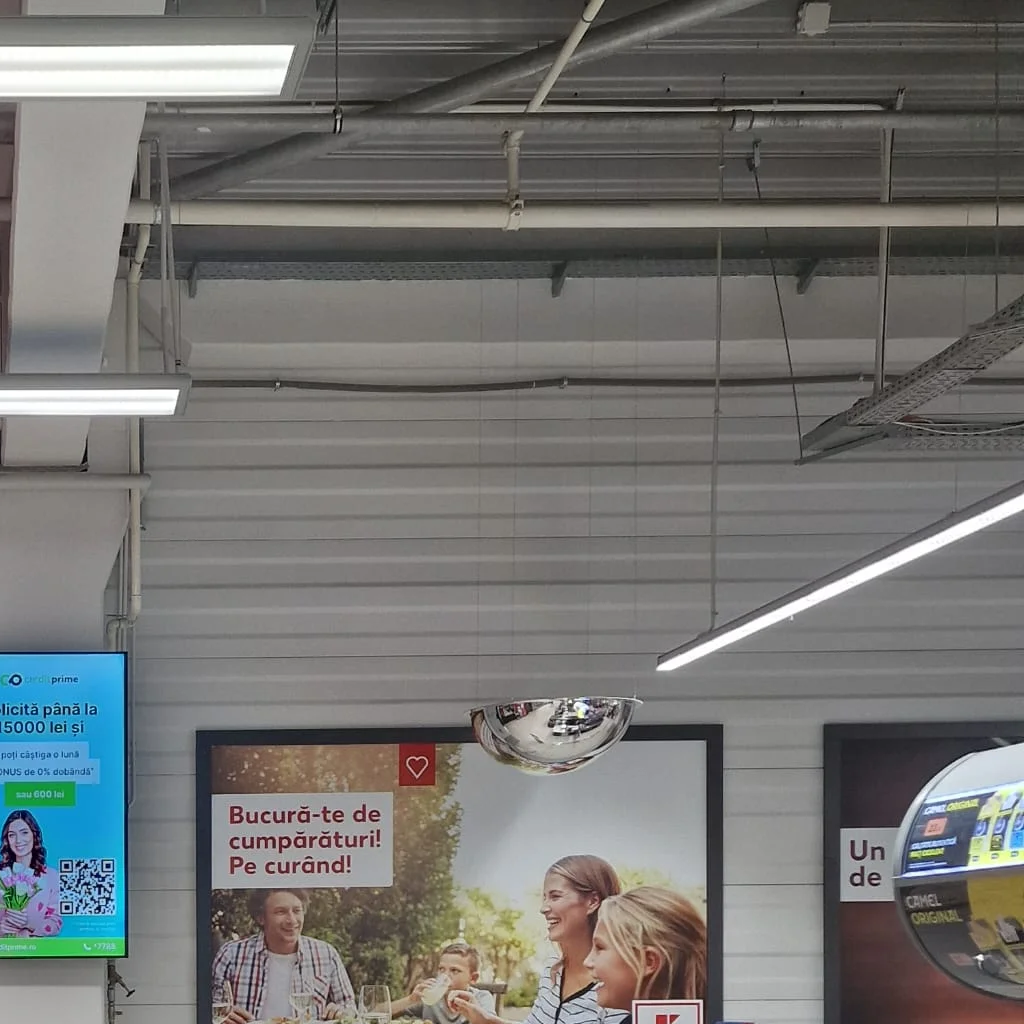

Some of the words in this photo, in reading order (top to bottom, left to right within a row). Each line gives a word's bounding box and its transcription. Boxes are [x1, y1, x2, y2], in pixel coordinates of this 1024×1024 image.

[43, 702, 81, 719] până
[85, 702, 98, 716] la
[50, 720, 67, 734] lei
[71, 720, 84, 737] și
[20, 750, 52, 761] câștiga
[61, 750, 80, 759] lună
[24, 767, 35, 776] de
[37, 768, 51, 776] 0%
[33, 790, 52, 799] 600
[54, 790, 65, 799] lei
[229, 804, 345, 824] Bucură-te
[353, 803, 381, 823] de
[229, 829, 381, 853] cumpărături!
[849, 840, 886, 861] Un
[229, 856, 257, 874] Pe
[265, 855, 352, 874] curând!
[849, 866, 883, 887] de
[905, 893, 943, 909] CAMEL
